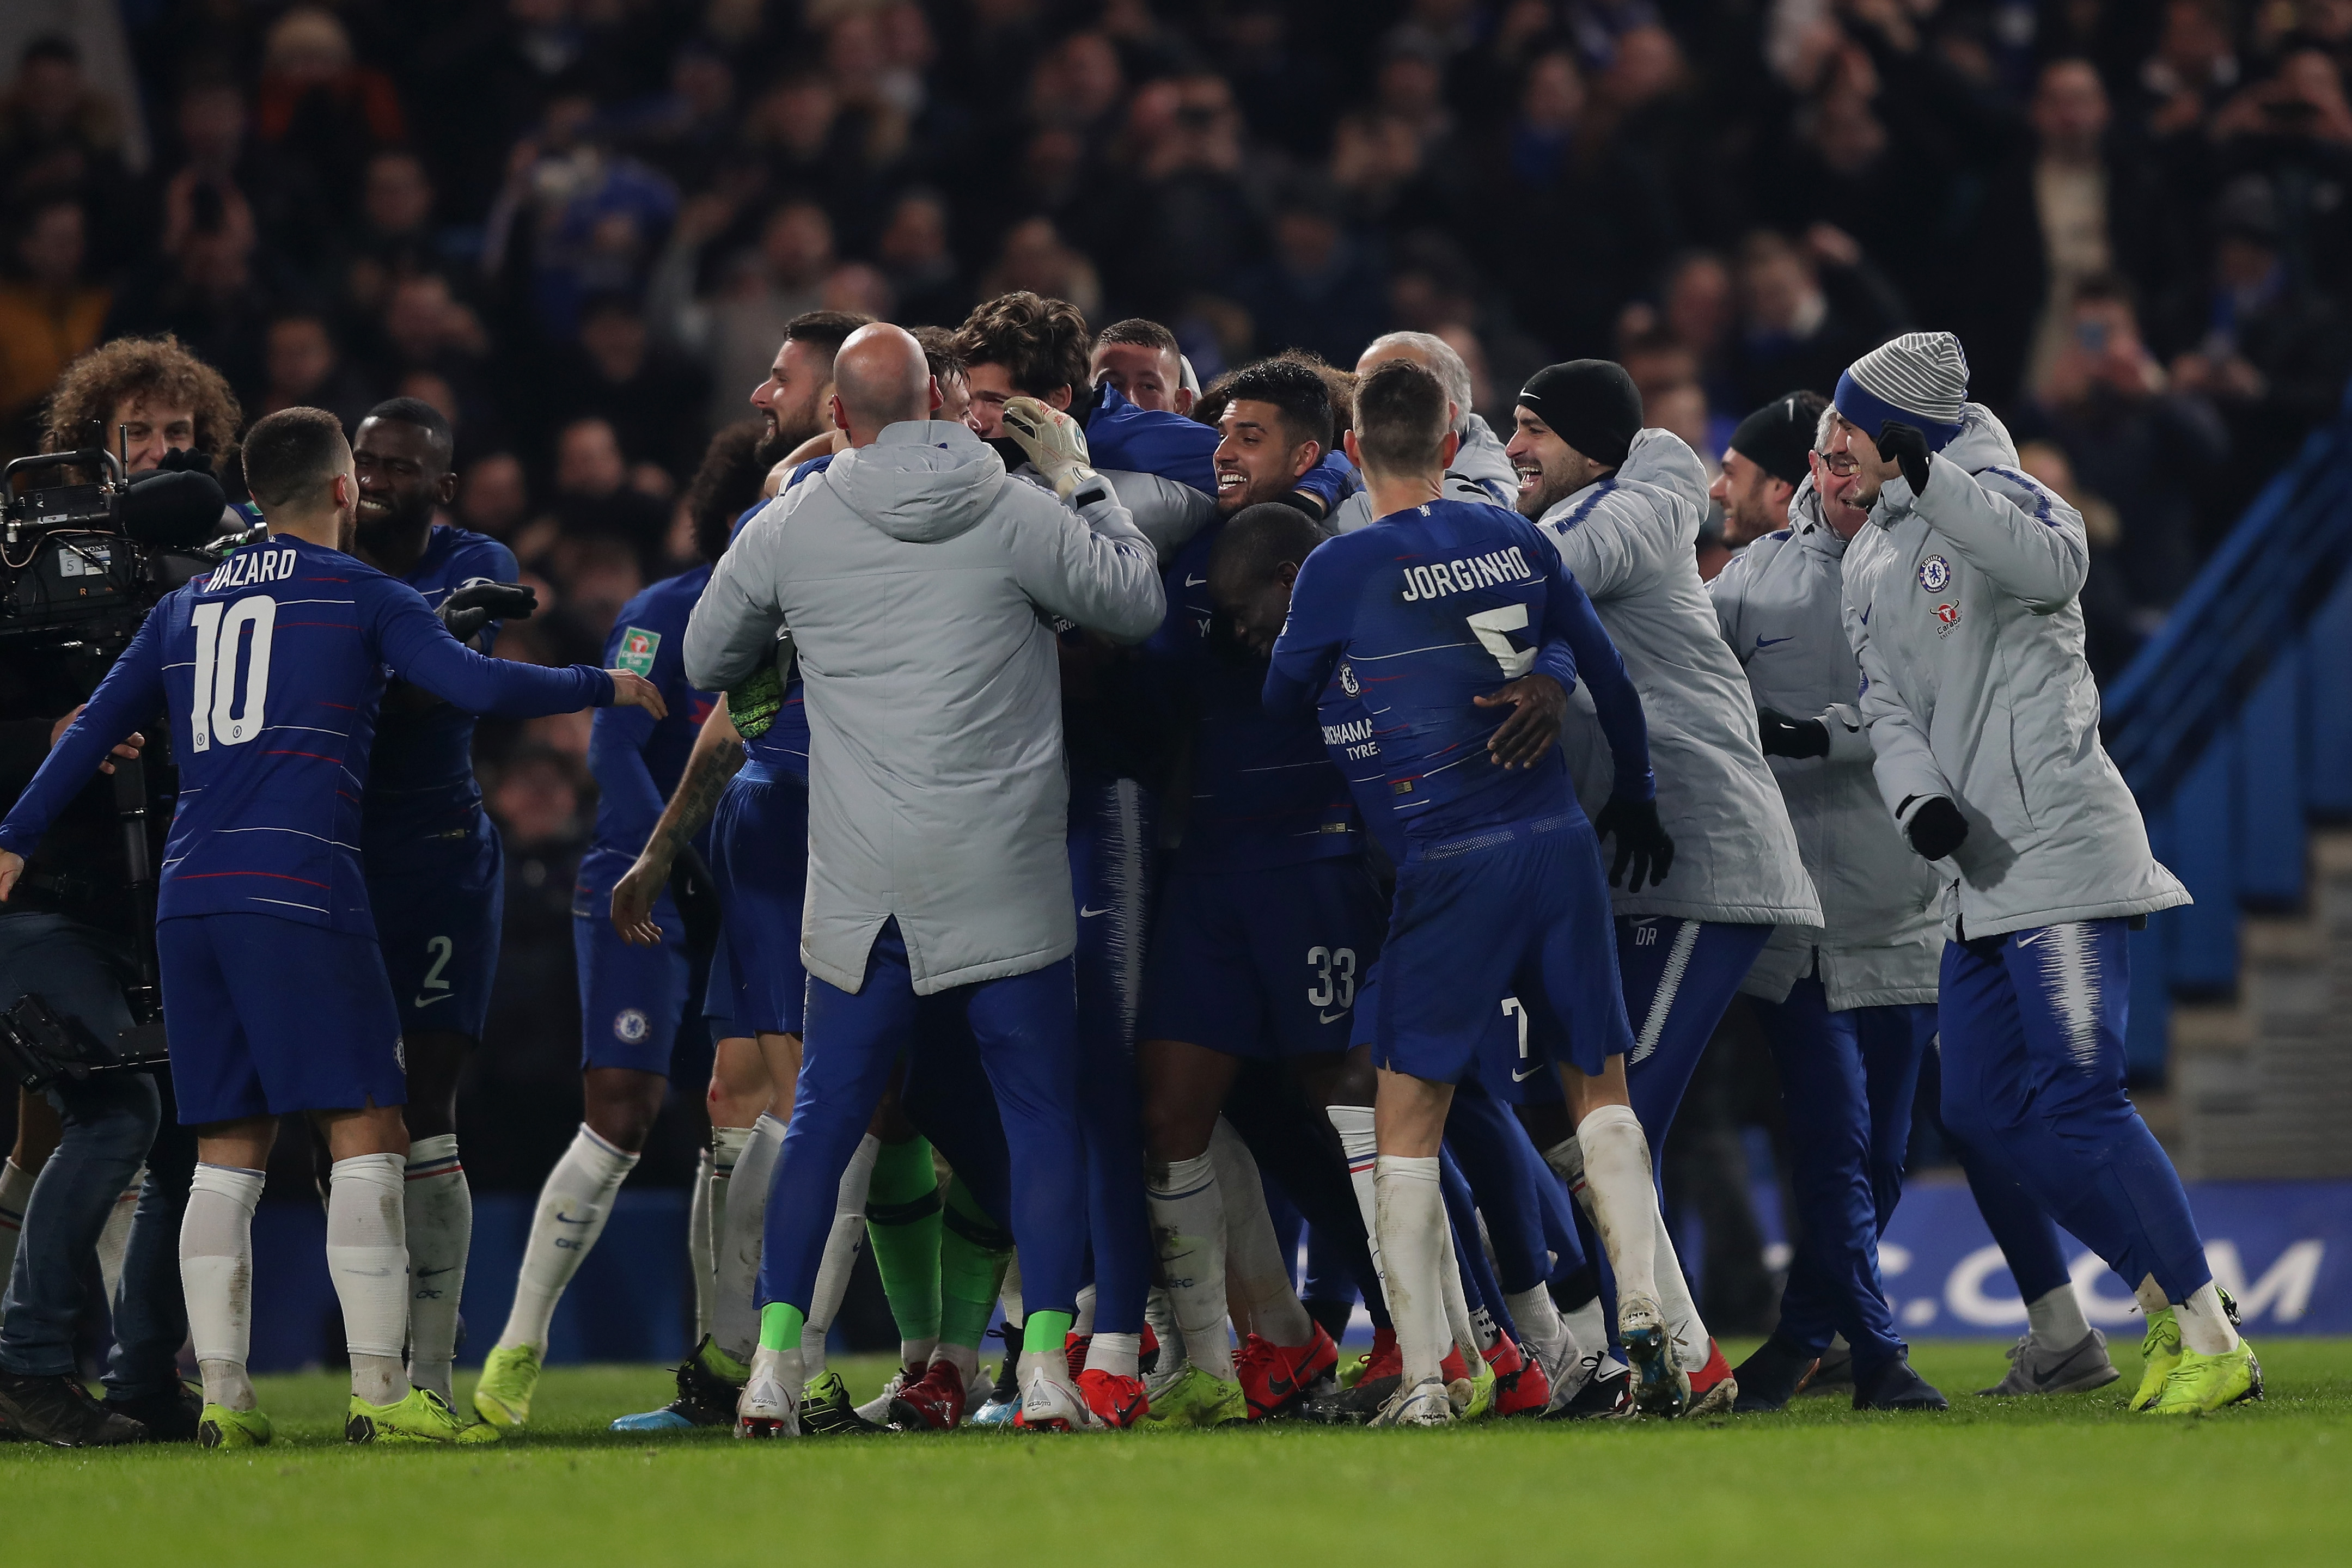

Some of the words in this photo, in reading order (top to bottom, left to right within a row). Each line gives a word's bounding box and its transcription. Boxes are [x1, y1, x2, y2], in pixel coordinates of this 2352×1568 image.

[67, 559, 74, 572] 5
[80, 587, 87, 596] R
[204, 549, 297, 593] HAZARD
[1402, 546, 1531, 602] JORGINHO
[1466, 603, 1538, 679] 5
[191, 595, 277, 754] 10
[1346, 741, 1381, 761] TYRE
[424, 936, 453, 989] 2
[1635, 927, 1657, 946] DR
[1308, 946, 1356, 1008] 33
[1501, 997, 1528, 1059] 7
